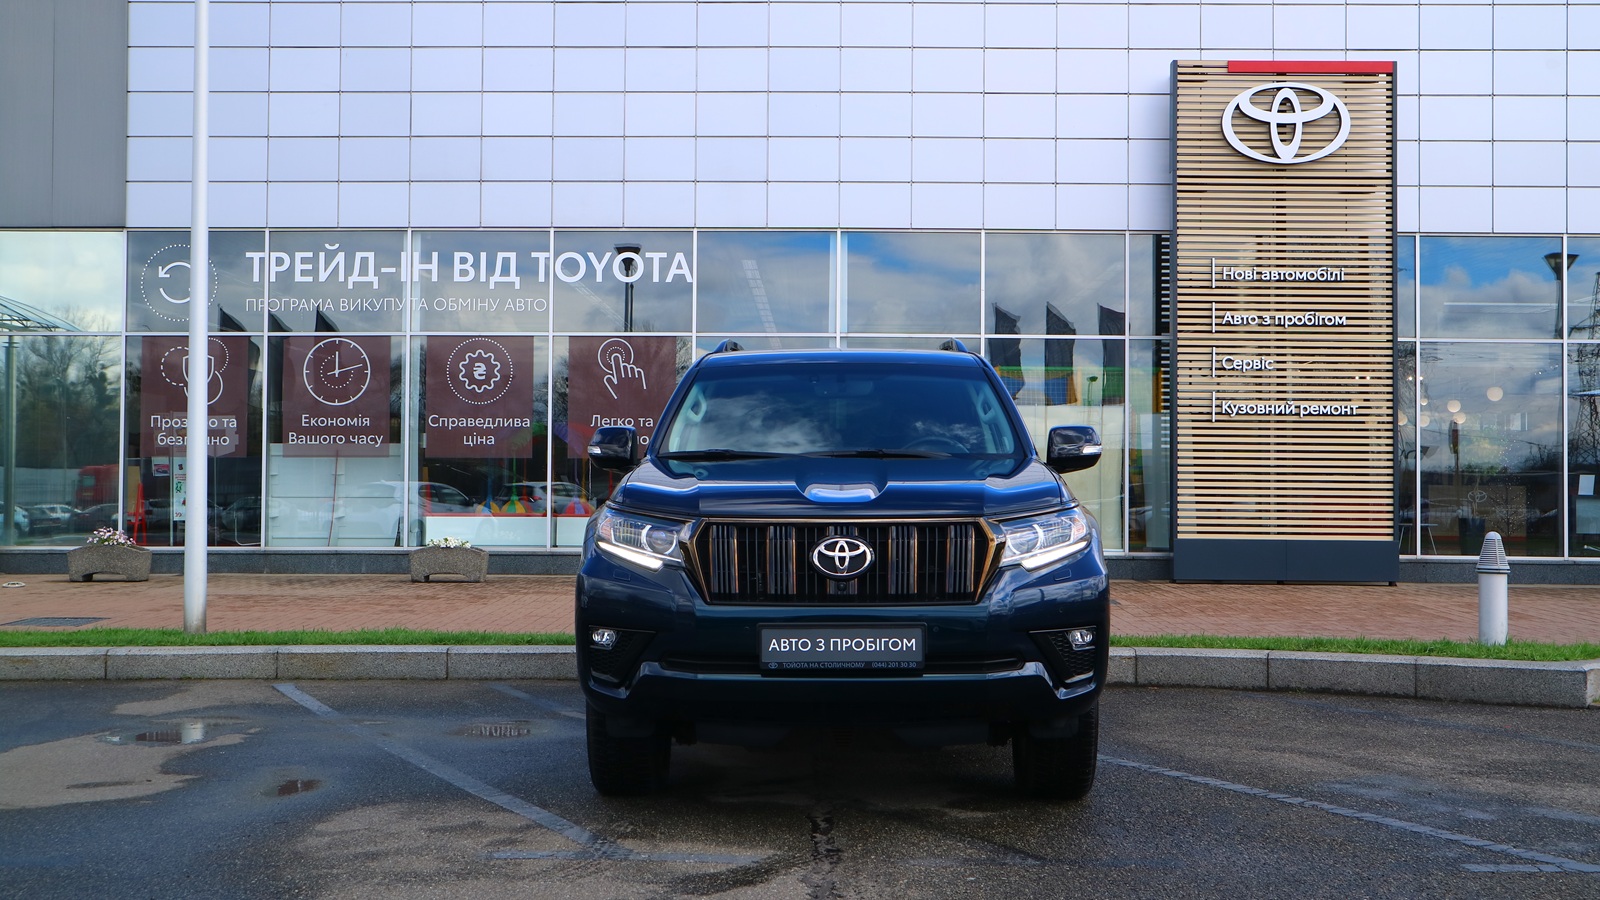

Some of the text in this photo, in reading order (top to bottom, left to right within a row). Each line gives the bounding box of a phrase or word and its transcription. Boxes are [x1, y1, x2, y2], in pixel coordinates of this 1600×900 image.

[246, 243, 694, 290] ТРЕЙД-ІН ВІД TOYOTA
[1222, 267, 1345, 281] Нові автомобілі
[245, 298, 547, 312] ПРОГРАМА ВИКУПУ ТА ОБМІНУ АВТО
[1222, 311, 1347, 328] Авто з пробігом
[1221, 356, 1275, 372] Сервіс
[1221, 400, 1359, 418] Кузовний ремонт
[150, 415, 237, 431] Прозо та
[301, 414, 370, 427] Економія
[428, 414, 531, 430] Справедлива
[590, 414, 654, 427] Легко та
[288, 432, 384, 448] Вашого часу
[463, 433, 495, 446] ціна
[768, 638, 916, 652] АВТО З ПРОБІГОМ
[783, 661, 808, 669] ТОЙОТА
